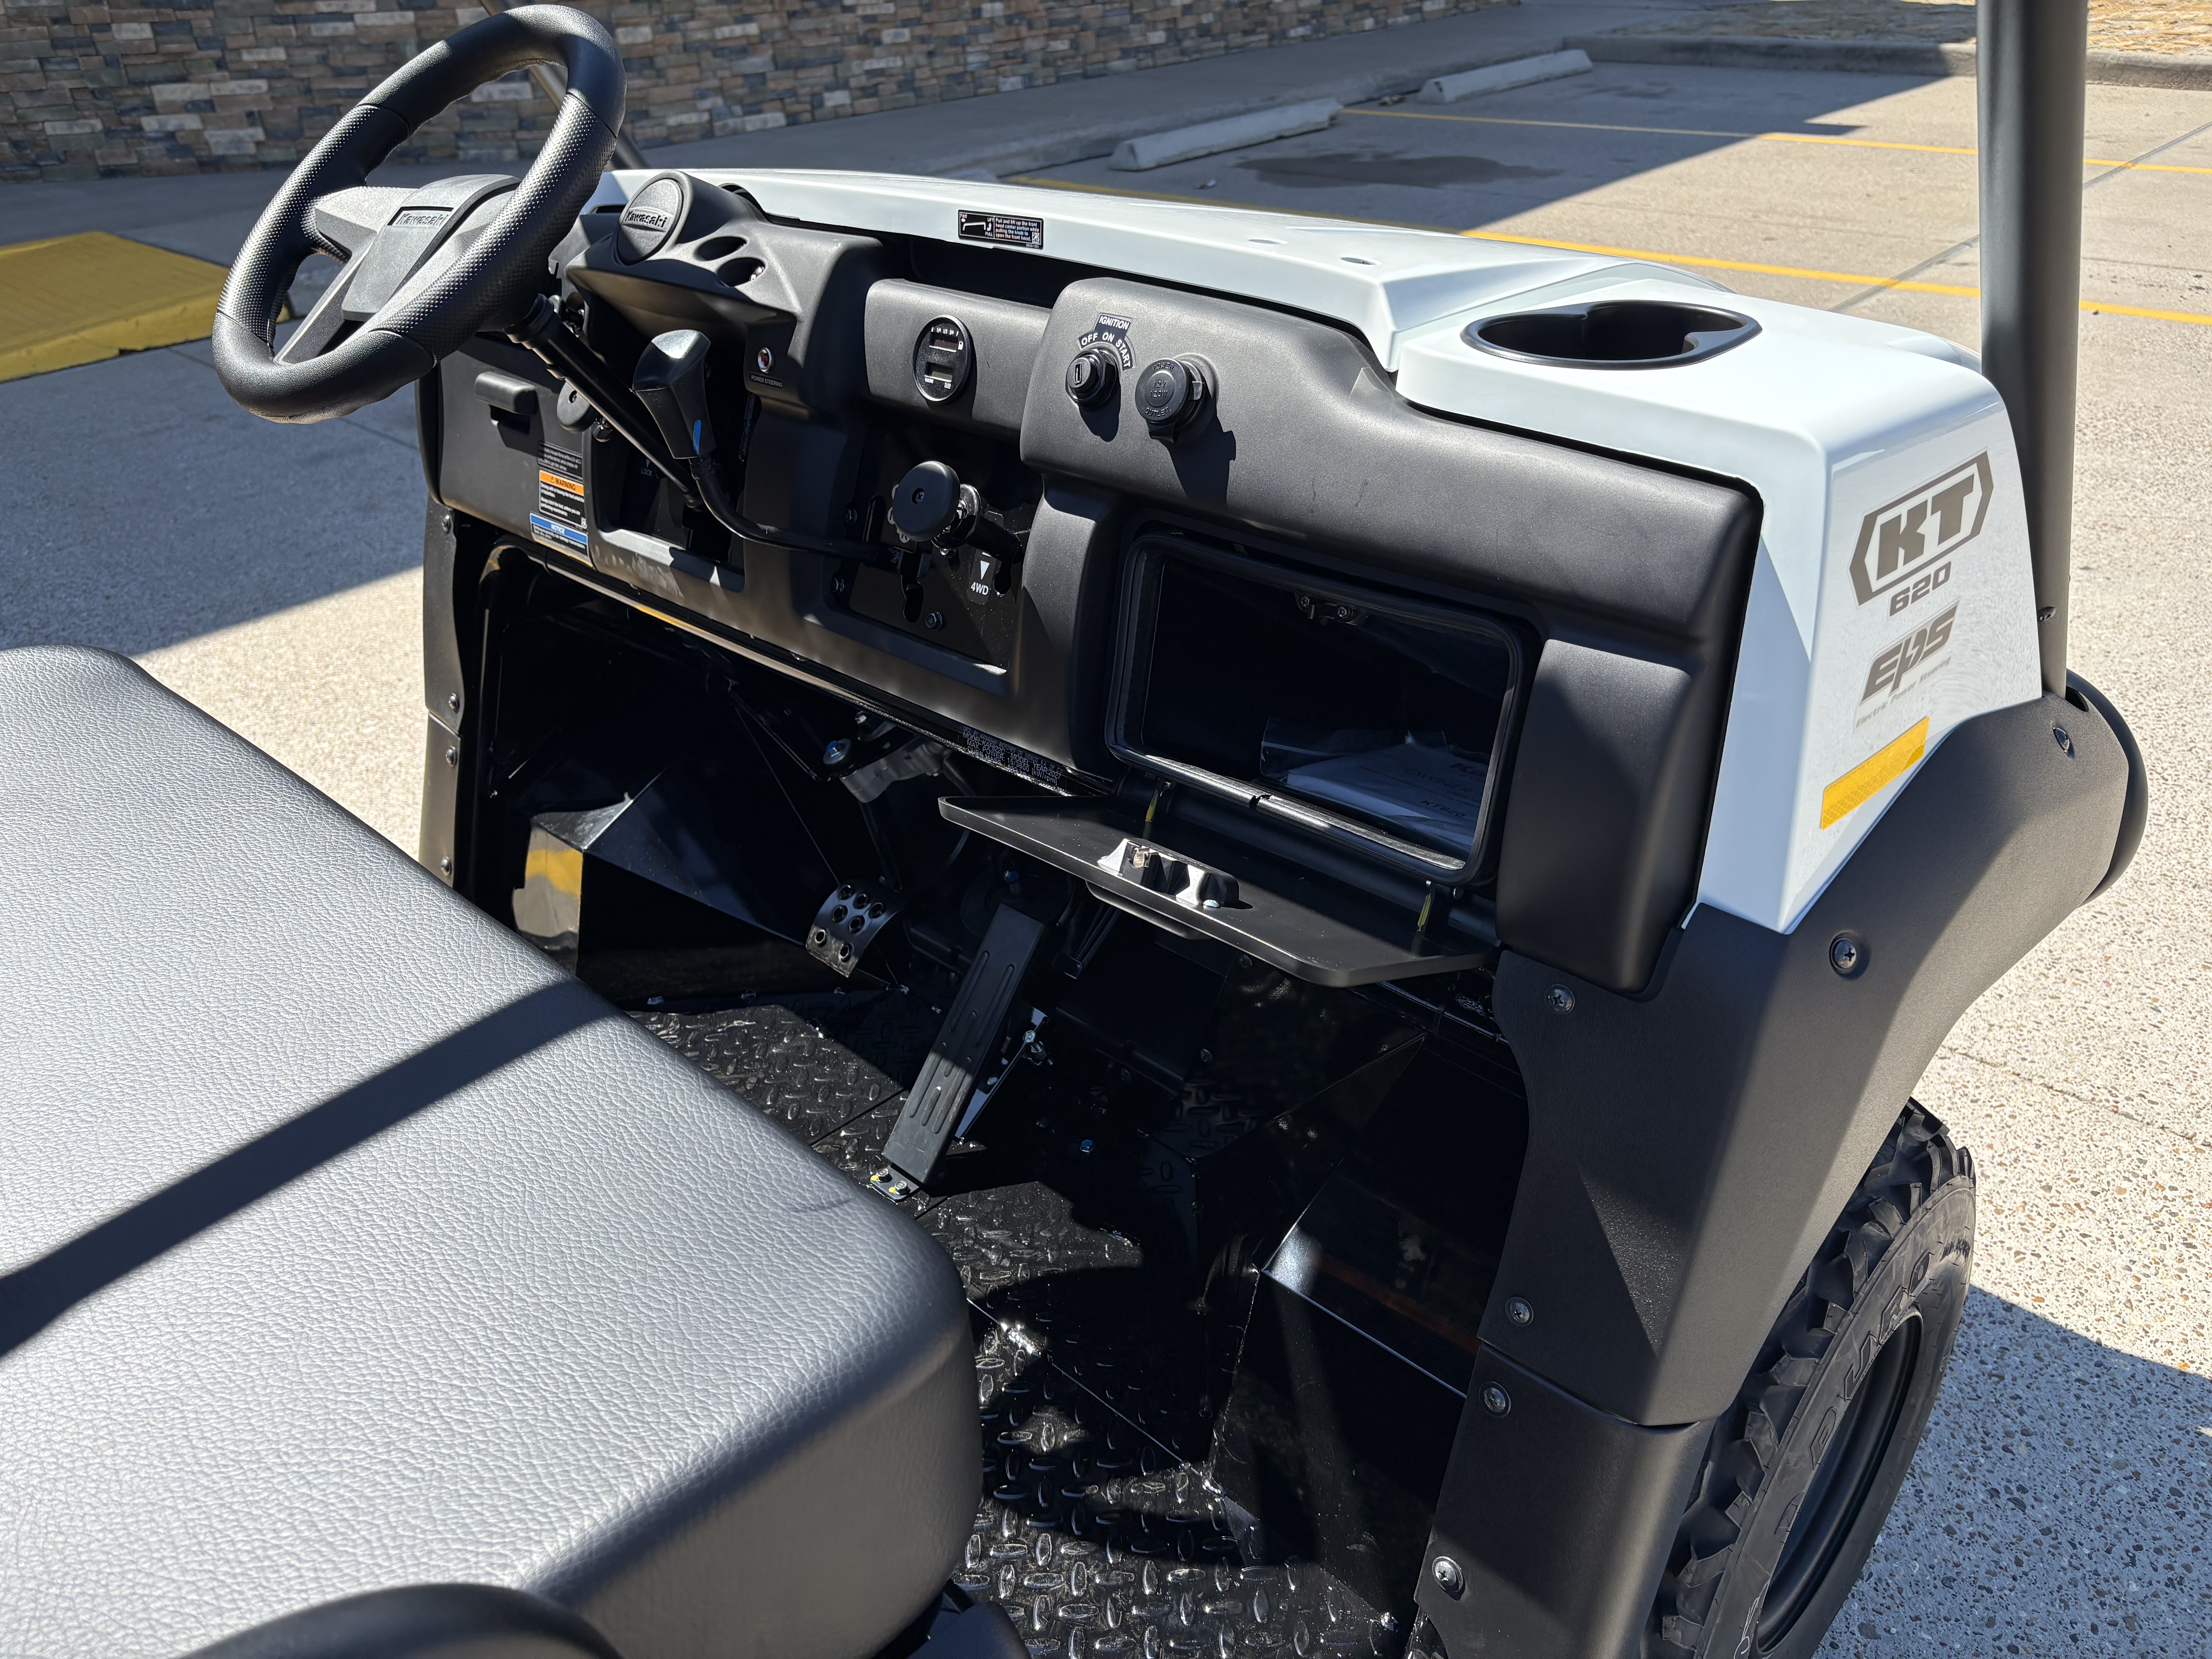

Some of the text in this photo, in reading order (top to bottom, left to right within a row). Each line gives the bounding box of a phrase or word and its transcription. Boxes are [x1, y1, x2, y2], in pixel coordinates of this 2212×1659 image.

[396, 213, 448, 227] Kawasaki
[625, 211, 668, 228] Kawasaki
[1099, 315, 1130, 330] IGNITION
[1081, 332, 1130, 368] OFF ON START
[1152, 362, 1174, 371] POWER
[751, 375, 783, 387] POWER STEERING
[641, 468, 652, 476] LOCK
[556, 477, 576, 491] WARNING
[1876, 473, 1974, 581] KT
[970, 582, 989, 595] 4WD
[1890, 561, 1951, 617] 620
[1862, 605, 1957, 702] EPS
[1856, 656, 1951, 728] Electric Power Steering
[982, 746, 1005, 761] POWER:
[1007, 757, 1029, 772] 15/3600
[1010, 752, 1029, 766] MODEL
